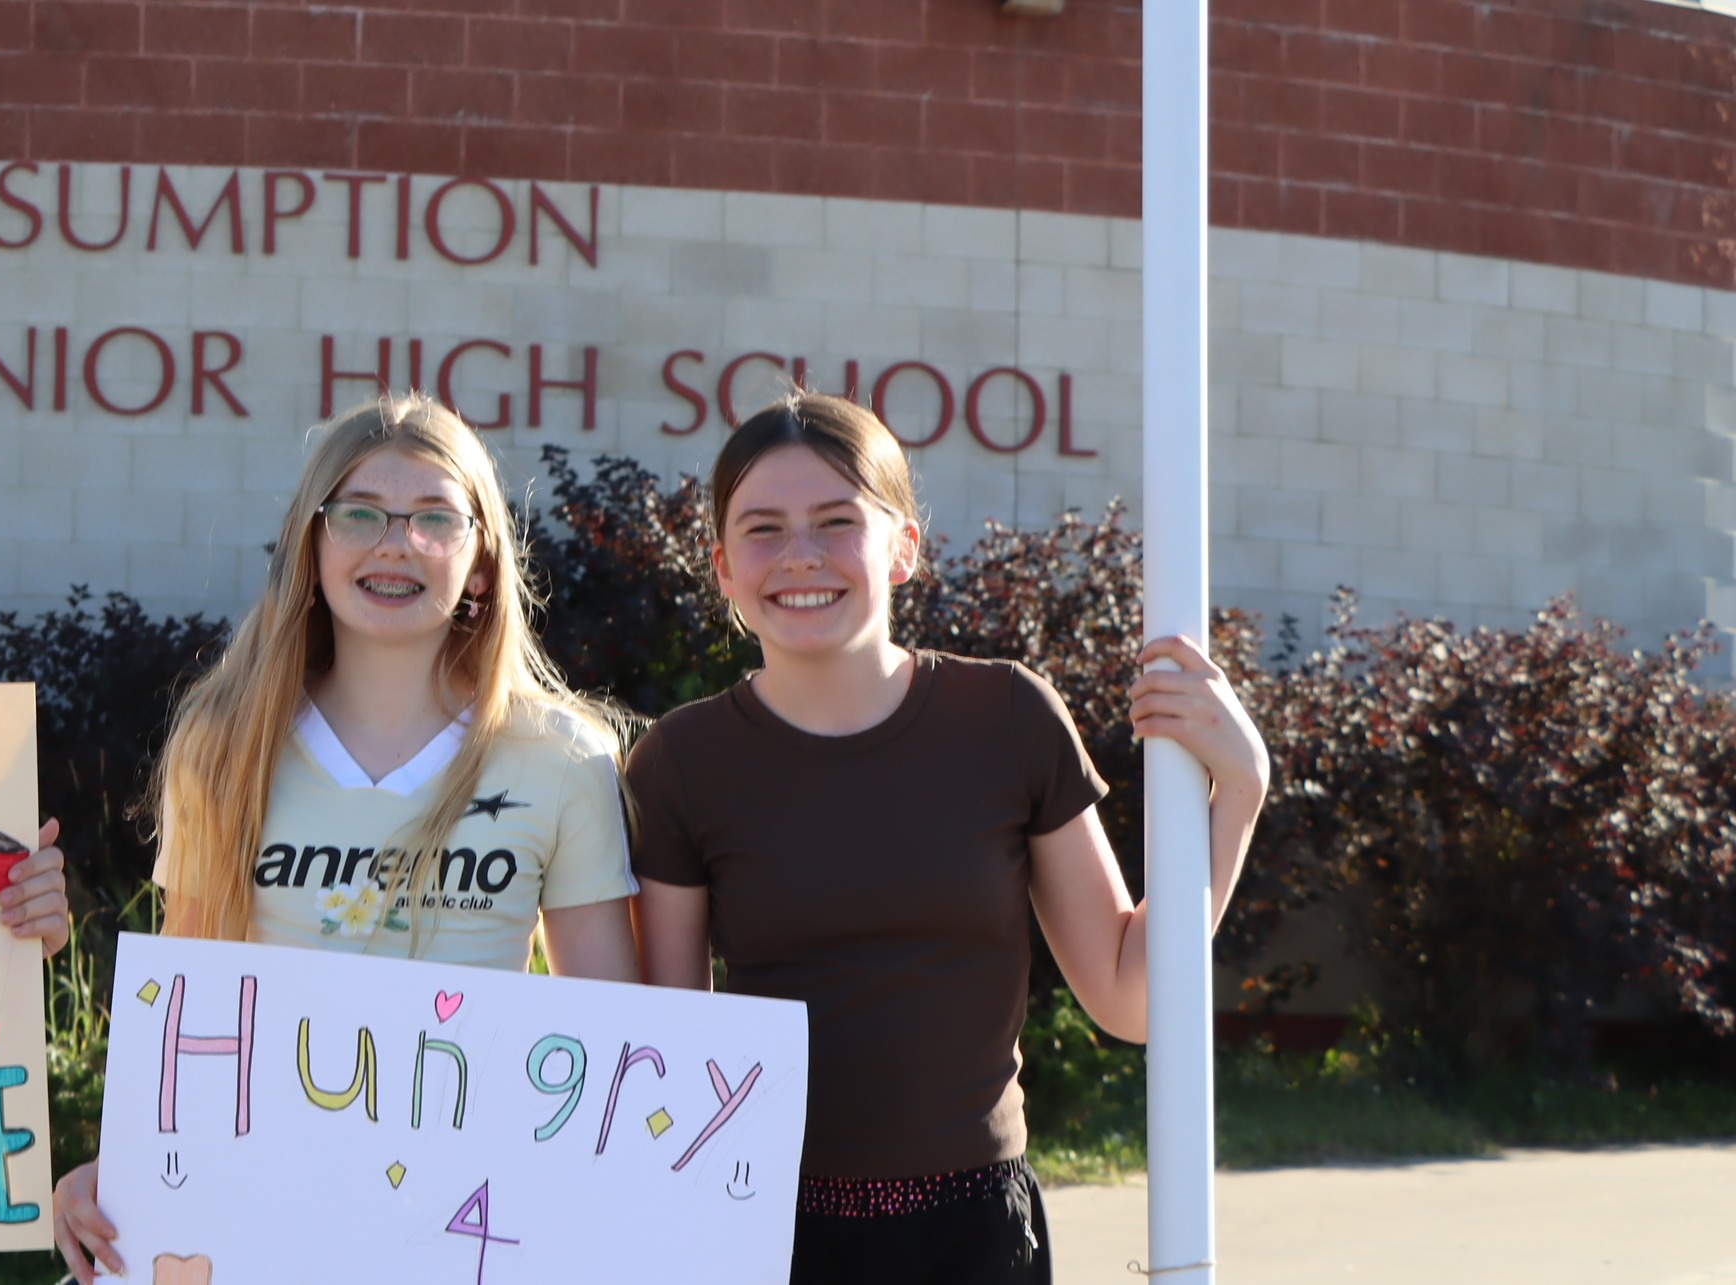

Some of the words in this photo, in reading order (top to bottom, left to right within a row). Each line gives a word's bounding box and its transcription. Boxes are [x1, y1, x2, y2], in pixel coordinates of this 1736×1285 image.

[319, 333, 599, 431] HIGH
[253, 842, 518, 894] anremo
[459, 894, 494, 911] club
[158, 974, 763, 1173] Hungry
